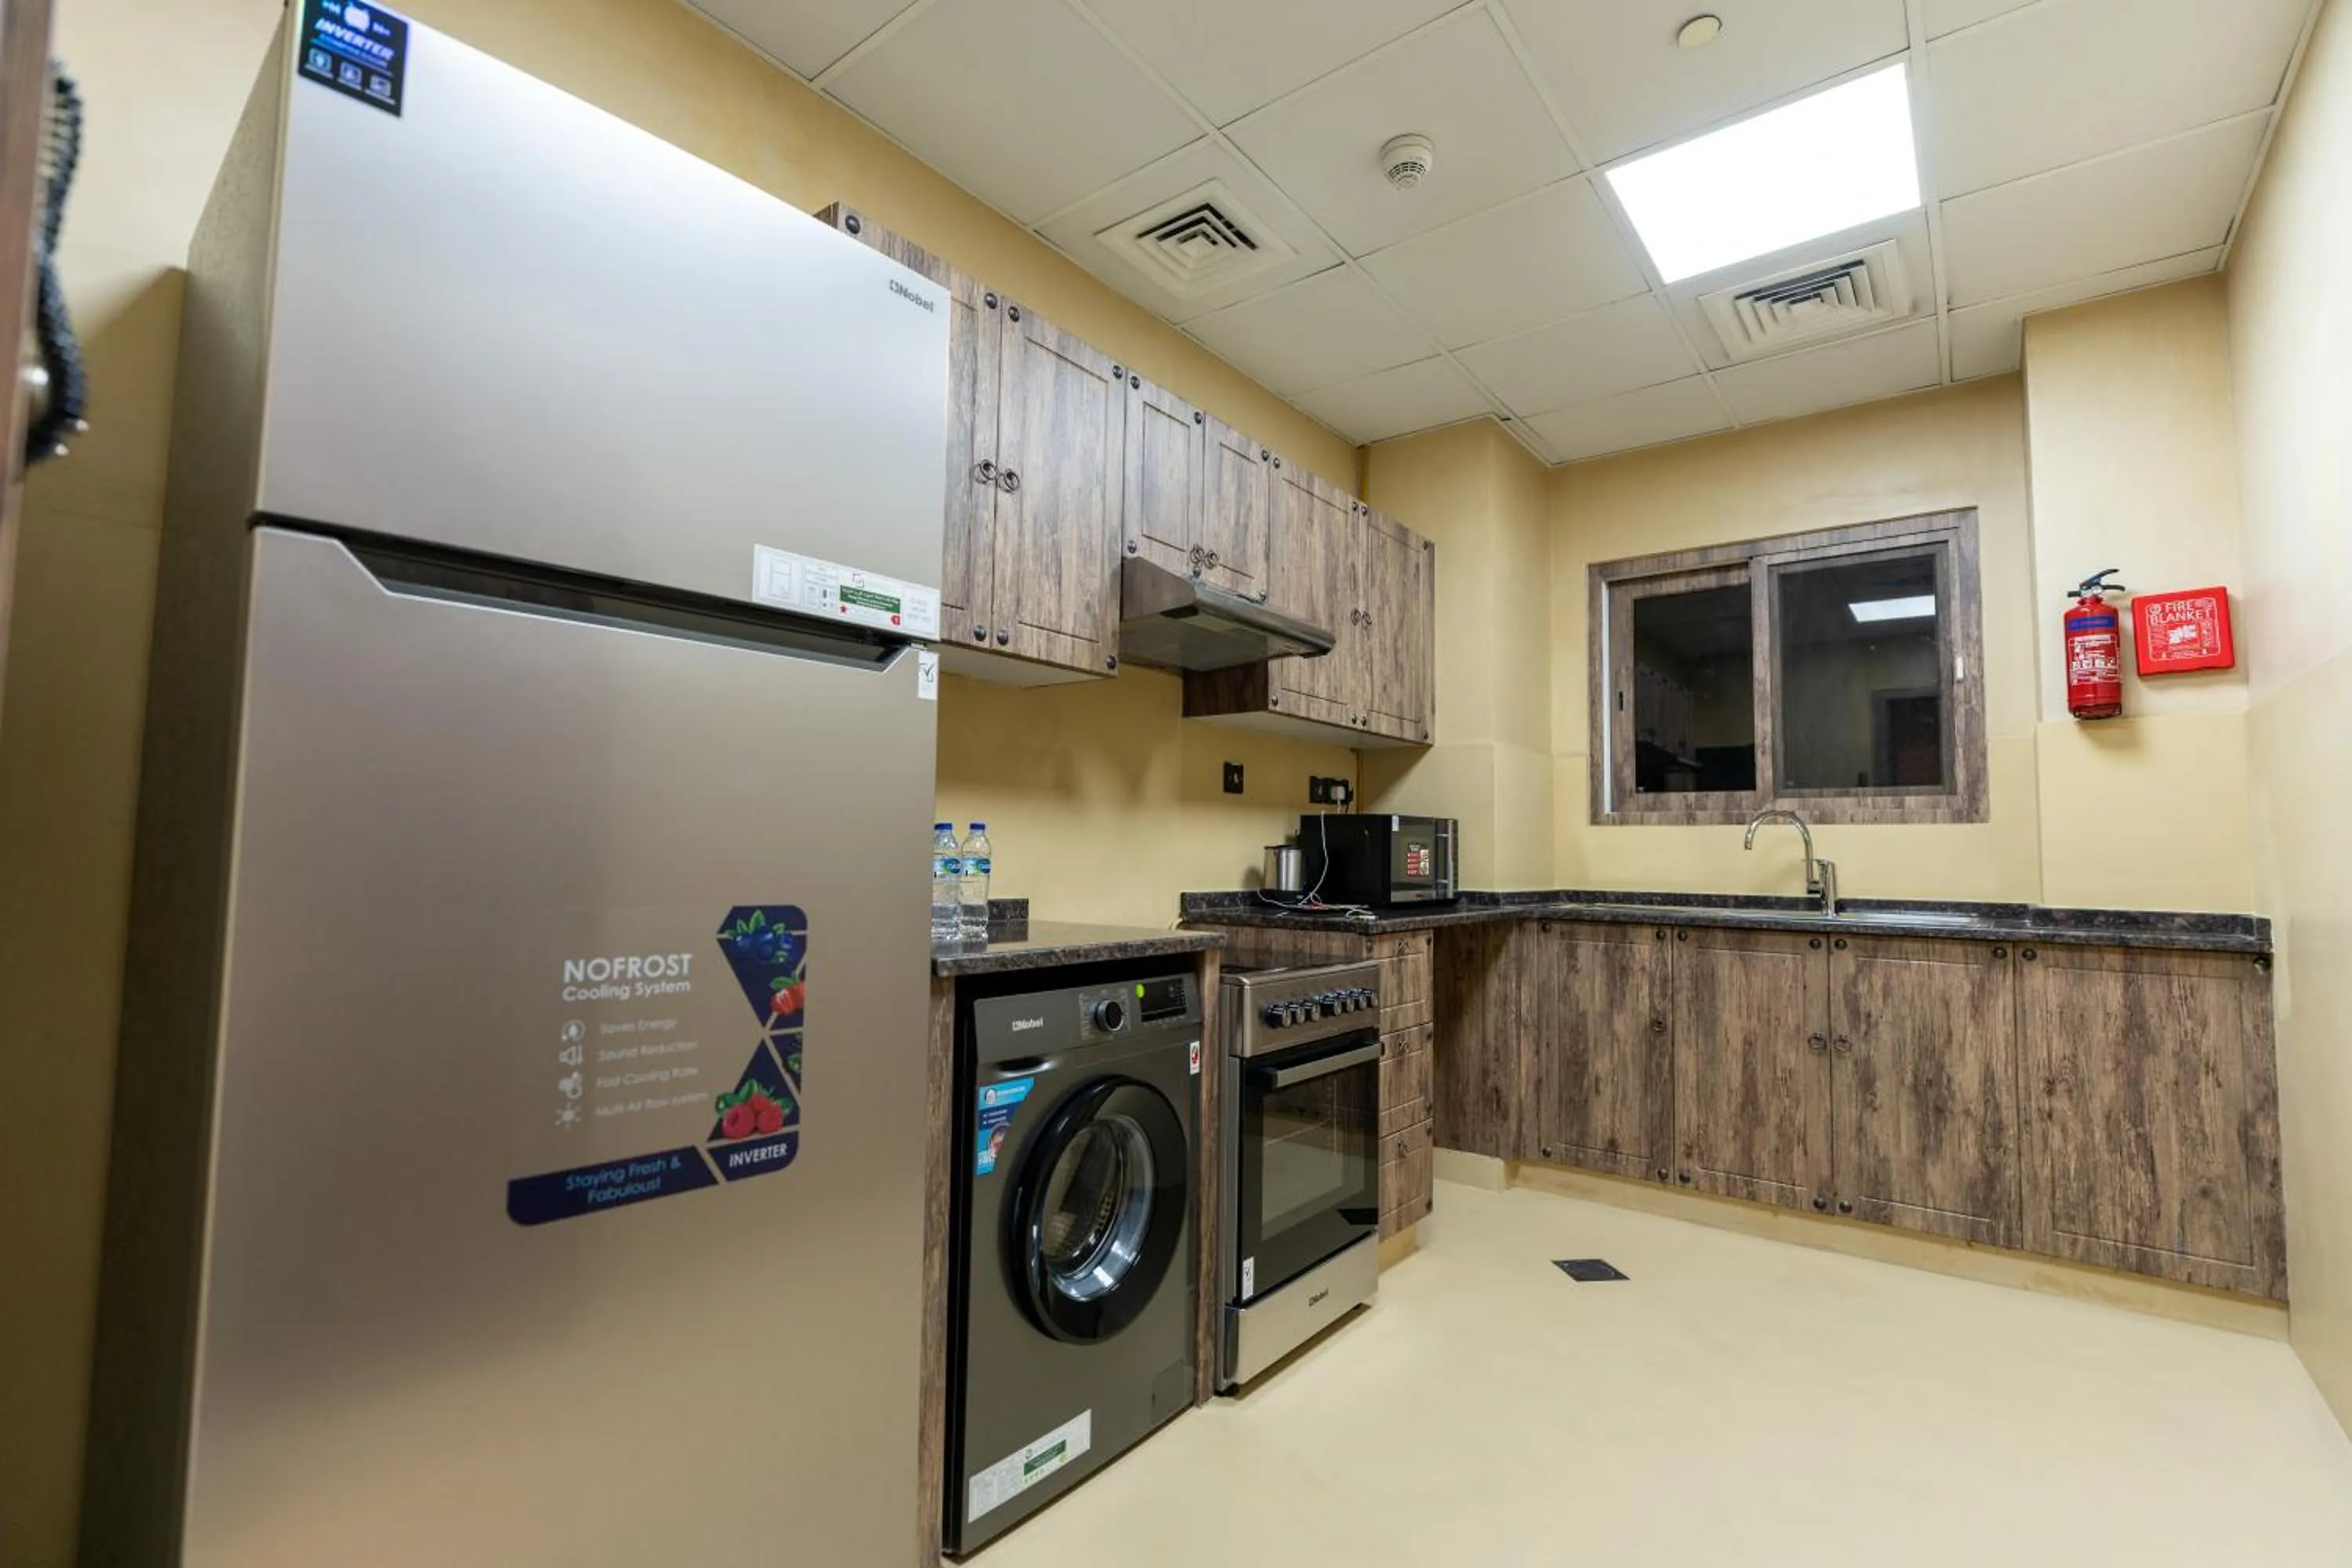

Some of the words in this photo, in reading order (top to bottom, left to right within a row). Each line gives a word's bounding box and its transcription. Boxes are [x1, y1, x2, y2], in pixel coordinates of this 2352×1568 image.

[314, 17, 394, 60] INVERTER
[899, 283, 935, 313] Nobel
[2151, 609, 2210, 627] BLANKET
[2164, 601, 2194, 613] FIRE
[563, 953, 693, 983] NOFROST
[562, 984, 630, 1002] Cooling
[634, 981, 691, 997] System
[728, 1143, 787, 1167] INVERTER
[565, 1168, 626, 1191] Staying
[628, 1158, 666, 1178] Fresh
[670, 1154, 682, 1170] &
[587, 1176, 662, 1204] Fabulous!
